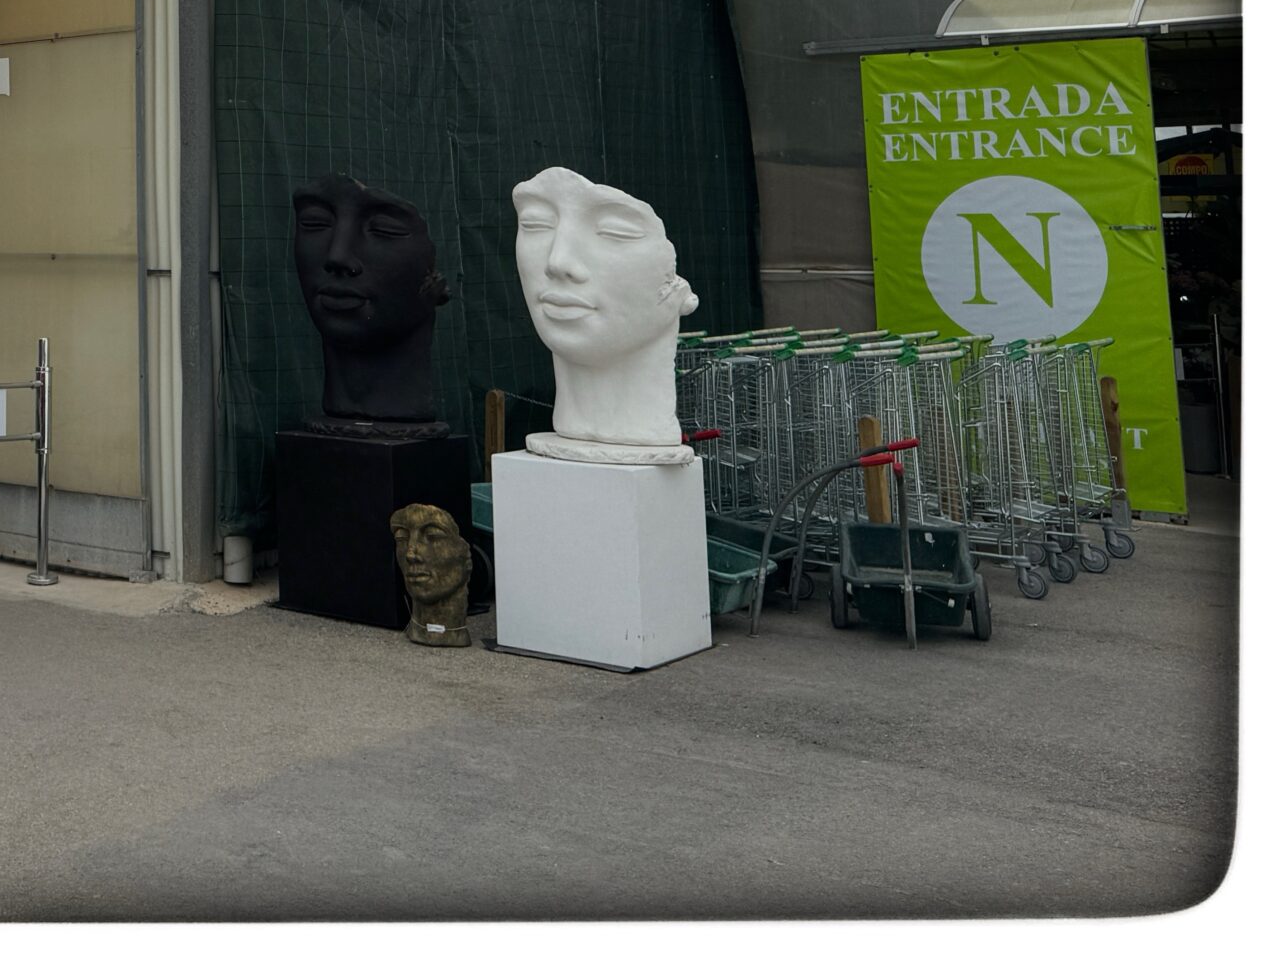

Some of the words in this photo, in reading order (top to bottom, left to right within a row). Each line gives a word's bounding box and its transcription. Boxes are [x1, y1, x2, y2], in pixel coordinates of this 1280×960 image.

[878, 81, 1133, 126] ENTRADA
[882, 125, 1137, 163] ENTRANCE
[956, 211, 1061, 309] N
